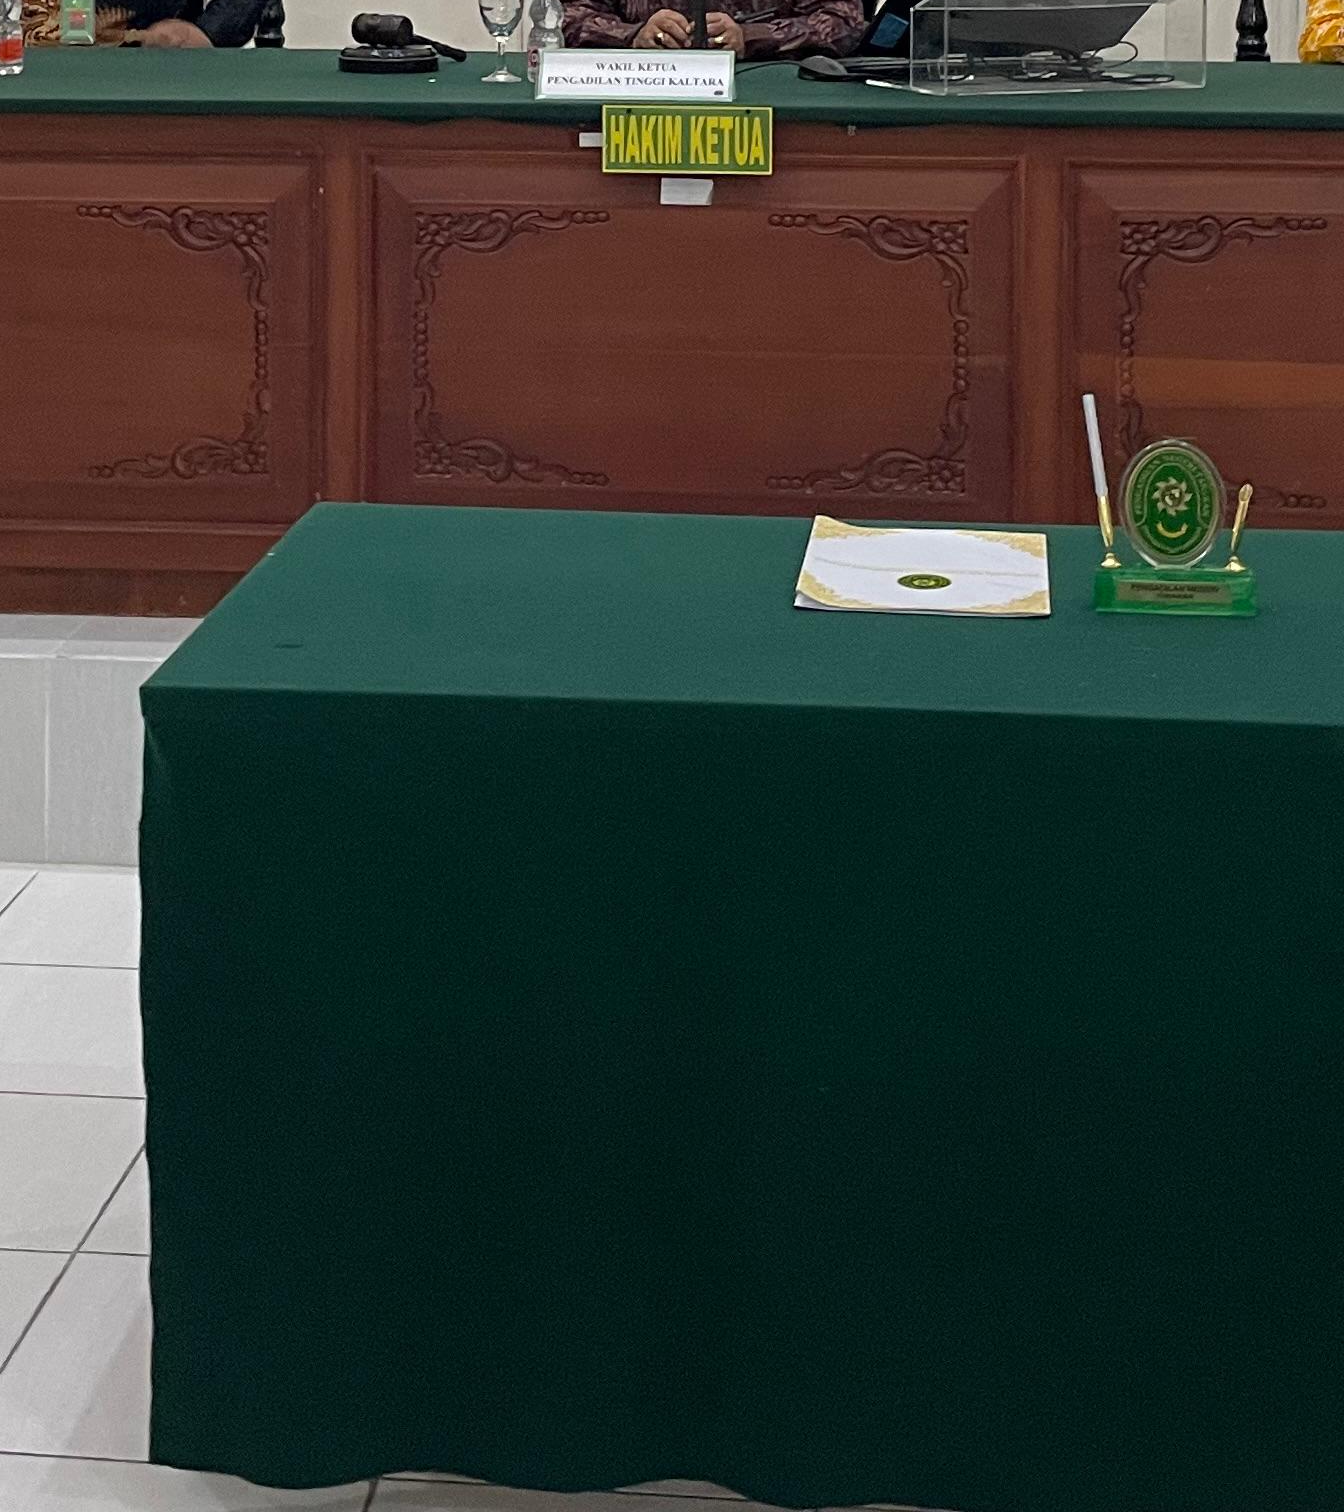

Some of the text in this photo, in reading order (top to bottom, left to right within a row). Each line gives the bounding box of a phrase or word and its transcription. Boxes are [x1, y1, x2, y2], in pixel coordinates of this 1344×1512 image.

[595, 62, 677, 72] WAKIL KETUA
[547, 76, 724, 87] PENGADILAN TINGGI KALTARA
[609, 115, 765, 166] HAKIM KETUA
